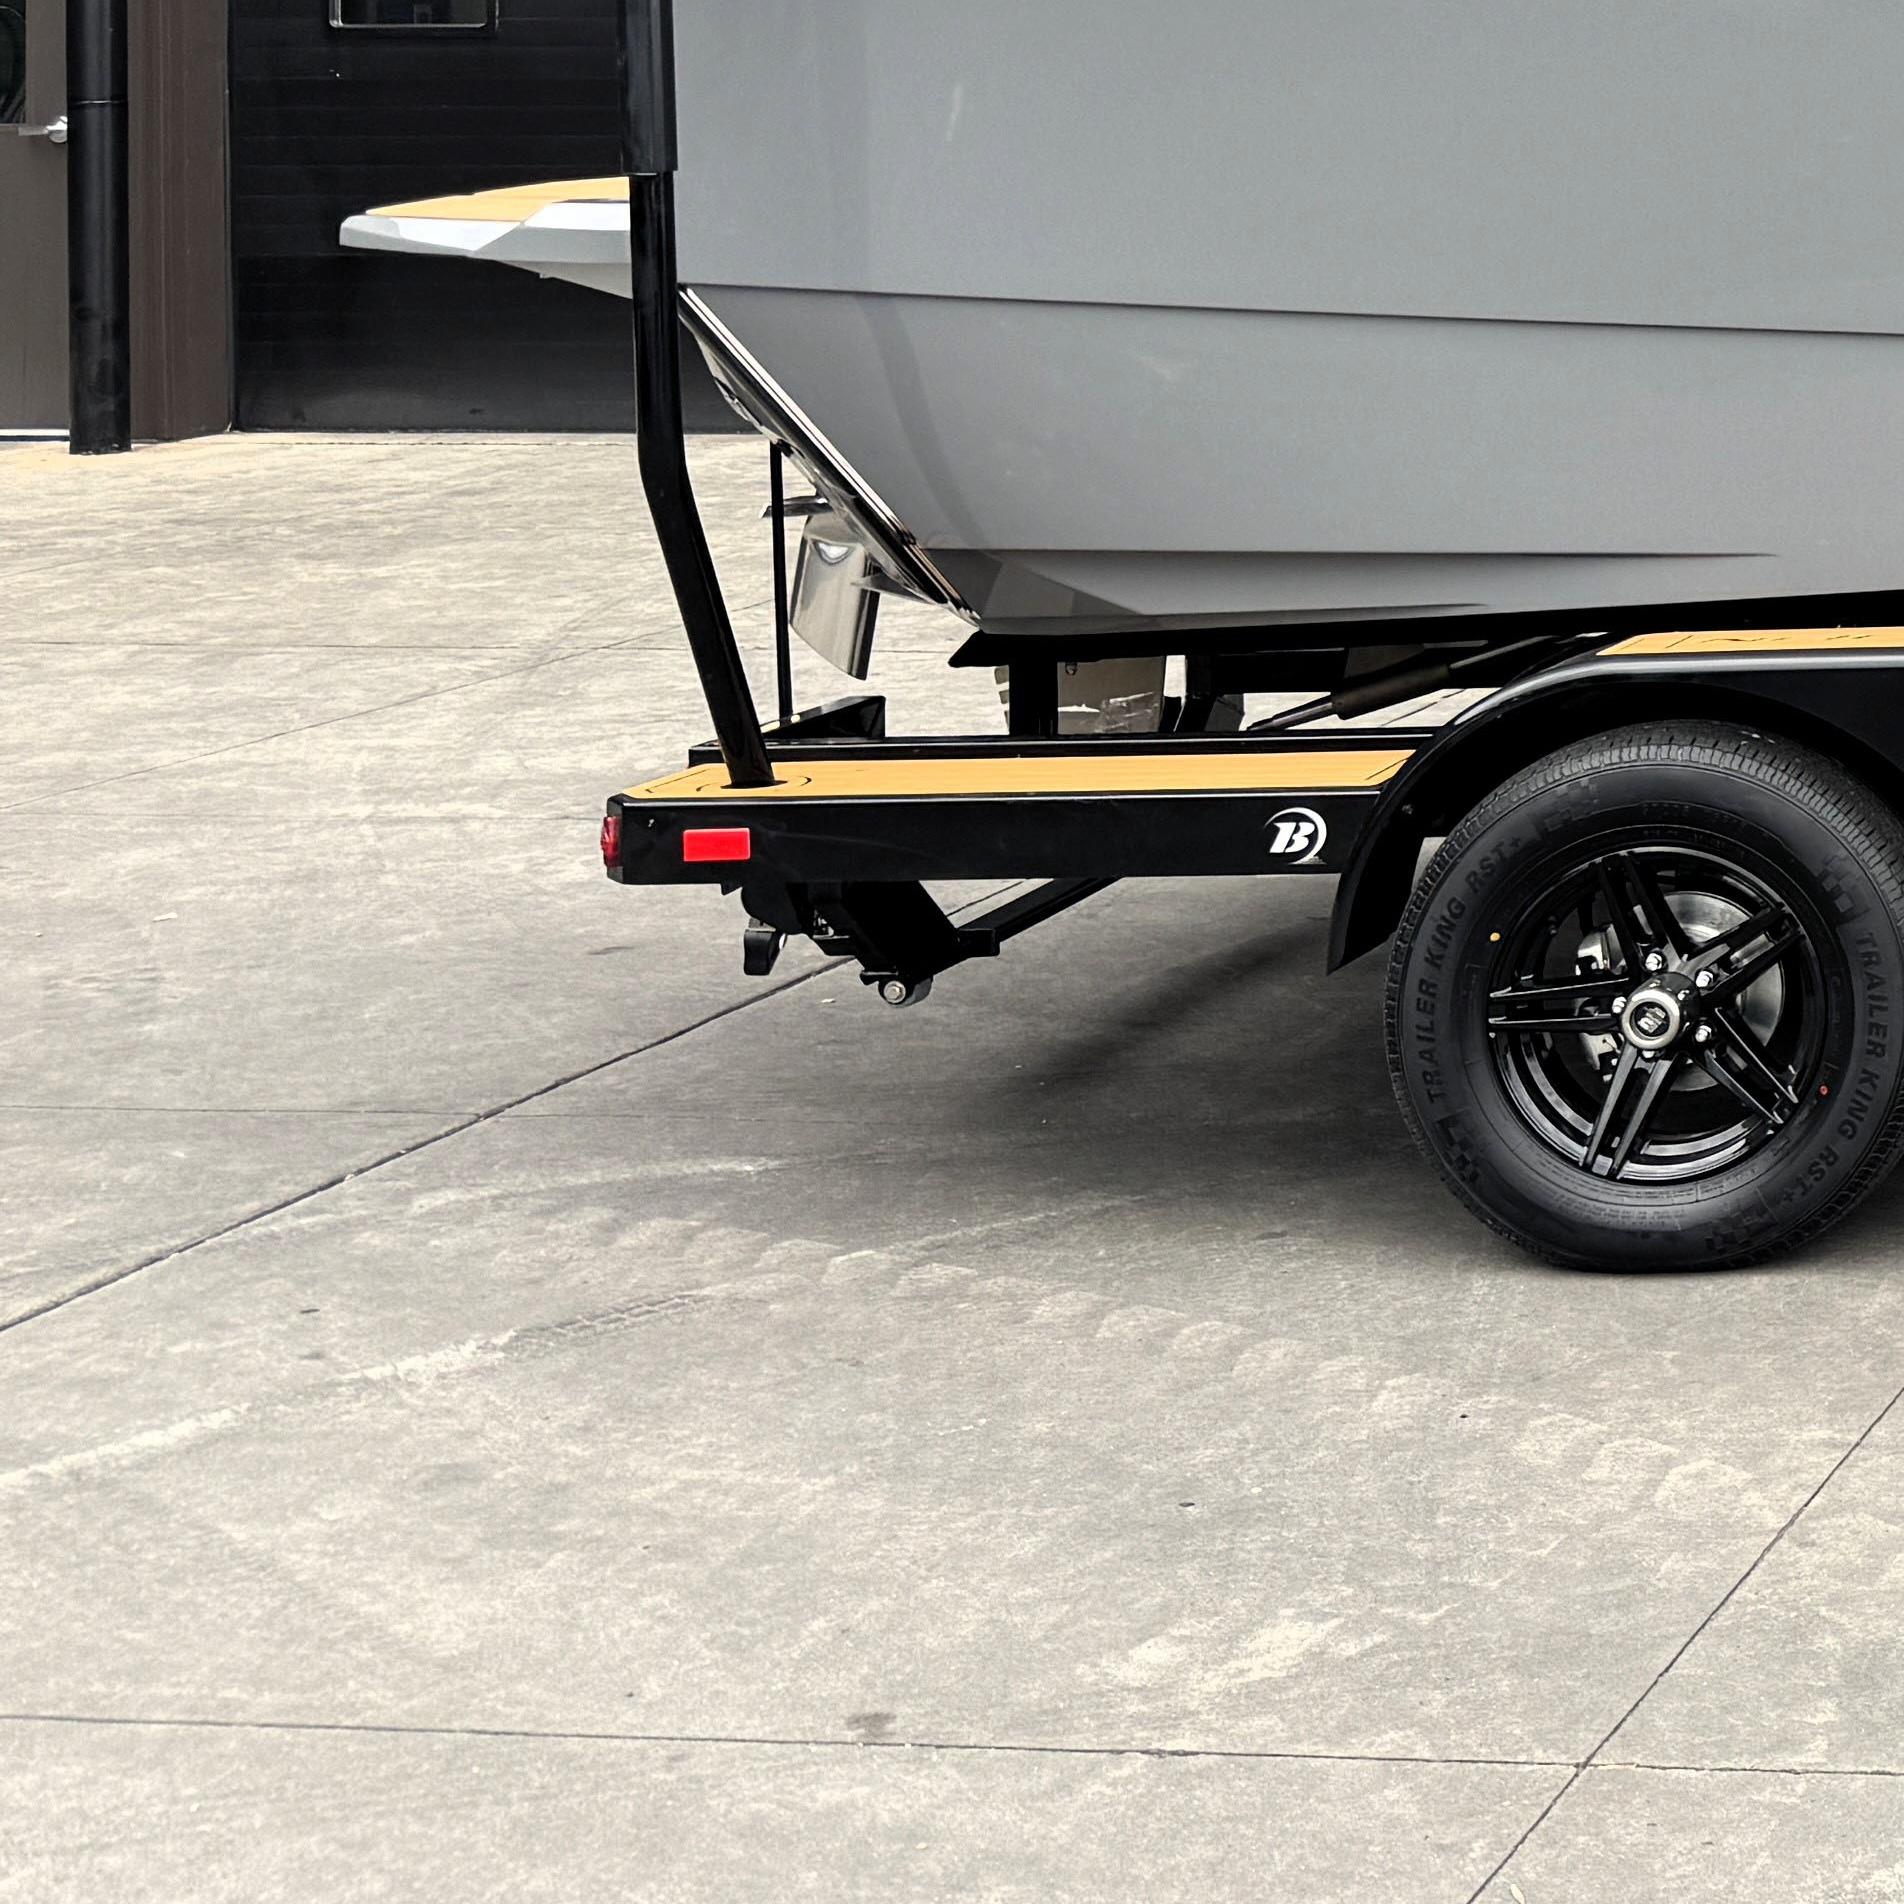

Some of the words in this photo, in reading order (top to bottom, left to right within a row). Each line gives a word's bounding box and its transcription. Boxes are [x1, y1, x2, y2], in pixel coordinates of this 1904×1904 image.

[1465, 835, 1524, 895] RST+
[1423, 895, 1467, 971] KING
[1854, 930, 1890, 1061] TRAILER
[1416, 976, 1449, 1106] TRAILER
[1836, 1066, 1881, 1142] KING
[1781, 1142, 1840, 1205] RST+
